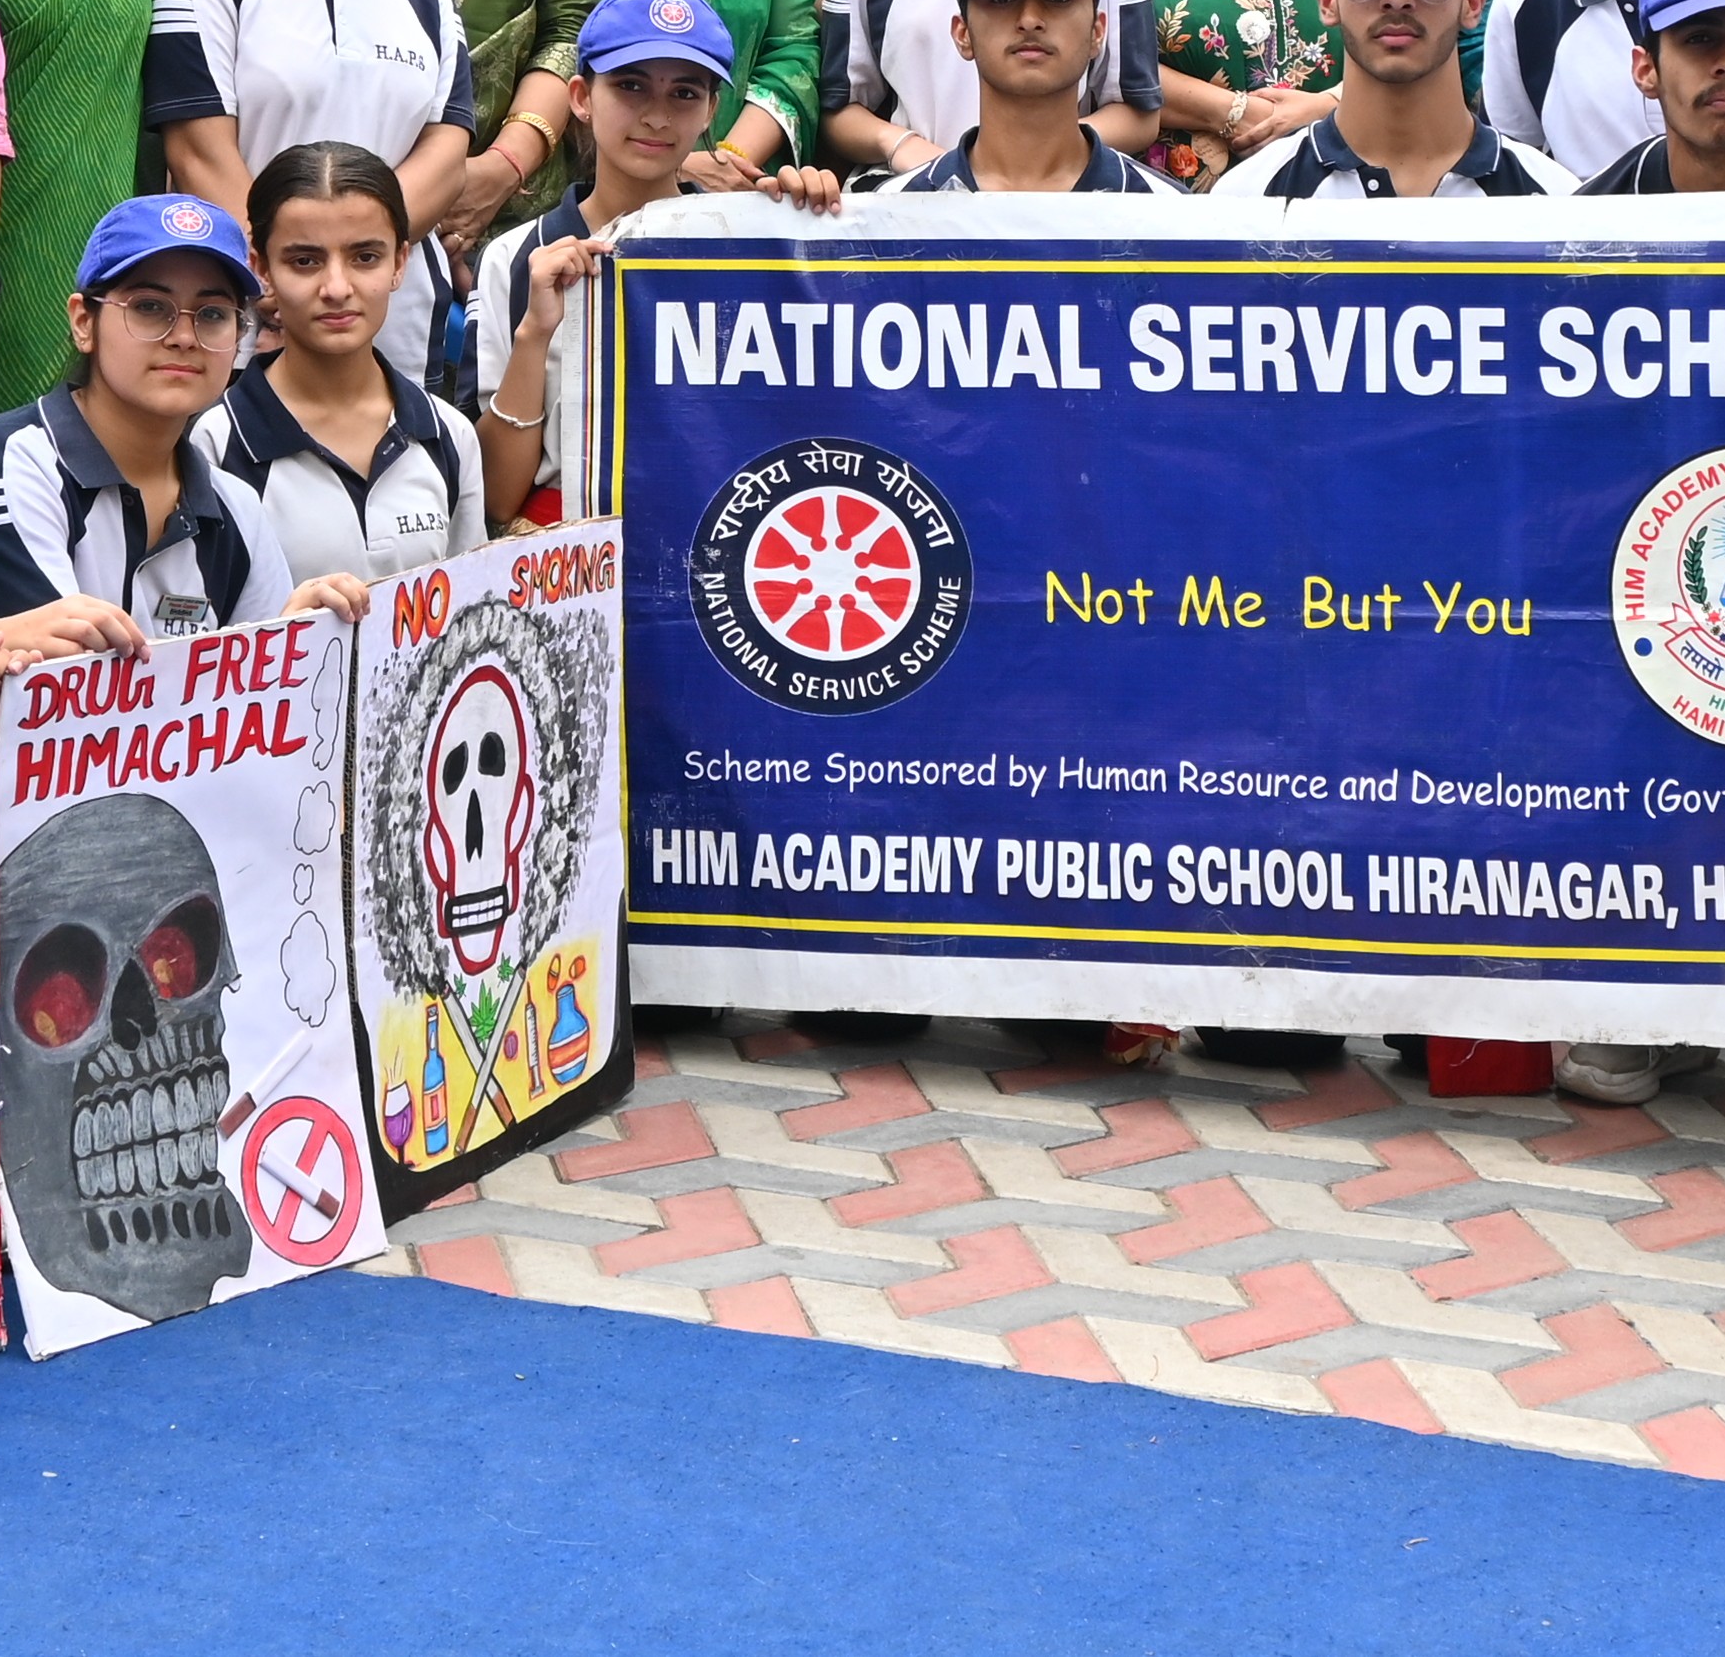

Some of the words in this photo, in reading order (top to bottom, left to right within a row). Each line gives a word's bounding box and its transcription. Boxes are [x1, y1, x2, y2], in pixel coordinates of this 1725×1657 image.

[375, 43, 426, 72] H.A.P.S
[653, 300, 1102, 392] NATIONAL
[1127, 303, 1507, 394] SERVICE
[396, 512, 445, 535] H.A.P.S
[710, 458, 791, 542] राष्ट्रीय
[797, 440, 864, 477] सेवा
[876, 460, 956, 549] योजना
[393, 571, 450, 649] NO
[509, 539, 615, 613] SMOKING
[702, 572, 778, 687] NATIONAL
[788, 664, 901, 701] SERVICE
[898, 575, 963, 675] SCHEME
[1043, 572, 1153, 627] Not
[1178, 574, 1266, 629] Me
[1302, 574, 1402, 633] But
[1423, 580, 1532, 637] You
[1624, 567, 1646, 622] HIM
[17, 655, 154, 730] DRUG
[180, 621, 313, 706] FREE
[1678, 639, 1725, 681] तमसो
[11, 697, 309, 805] HIMACHAL
[684, 750, 812, 784] Scheme
[824, 752, 998, 793] Sponsored
[1008, 755, 1048, 798] by
[1058, 757, 1169, 794] Human
[1178, 760, 1329, 801] Resource
[1338, 767, 1400, 805] and
[1411, 768, 1631, 819] Development
[650, 828, 740, 888] HIM
[750, 831, 984, 895] ACADEMY
[996, 838, 1154, 903] PUBLIC
[1167, 844, 1355, 912] SCHOOL
[1367, 853, 1680, 930] HIRANAGAR,
